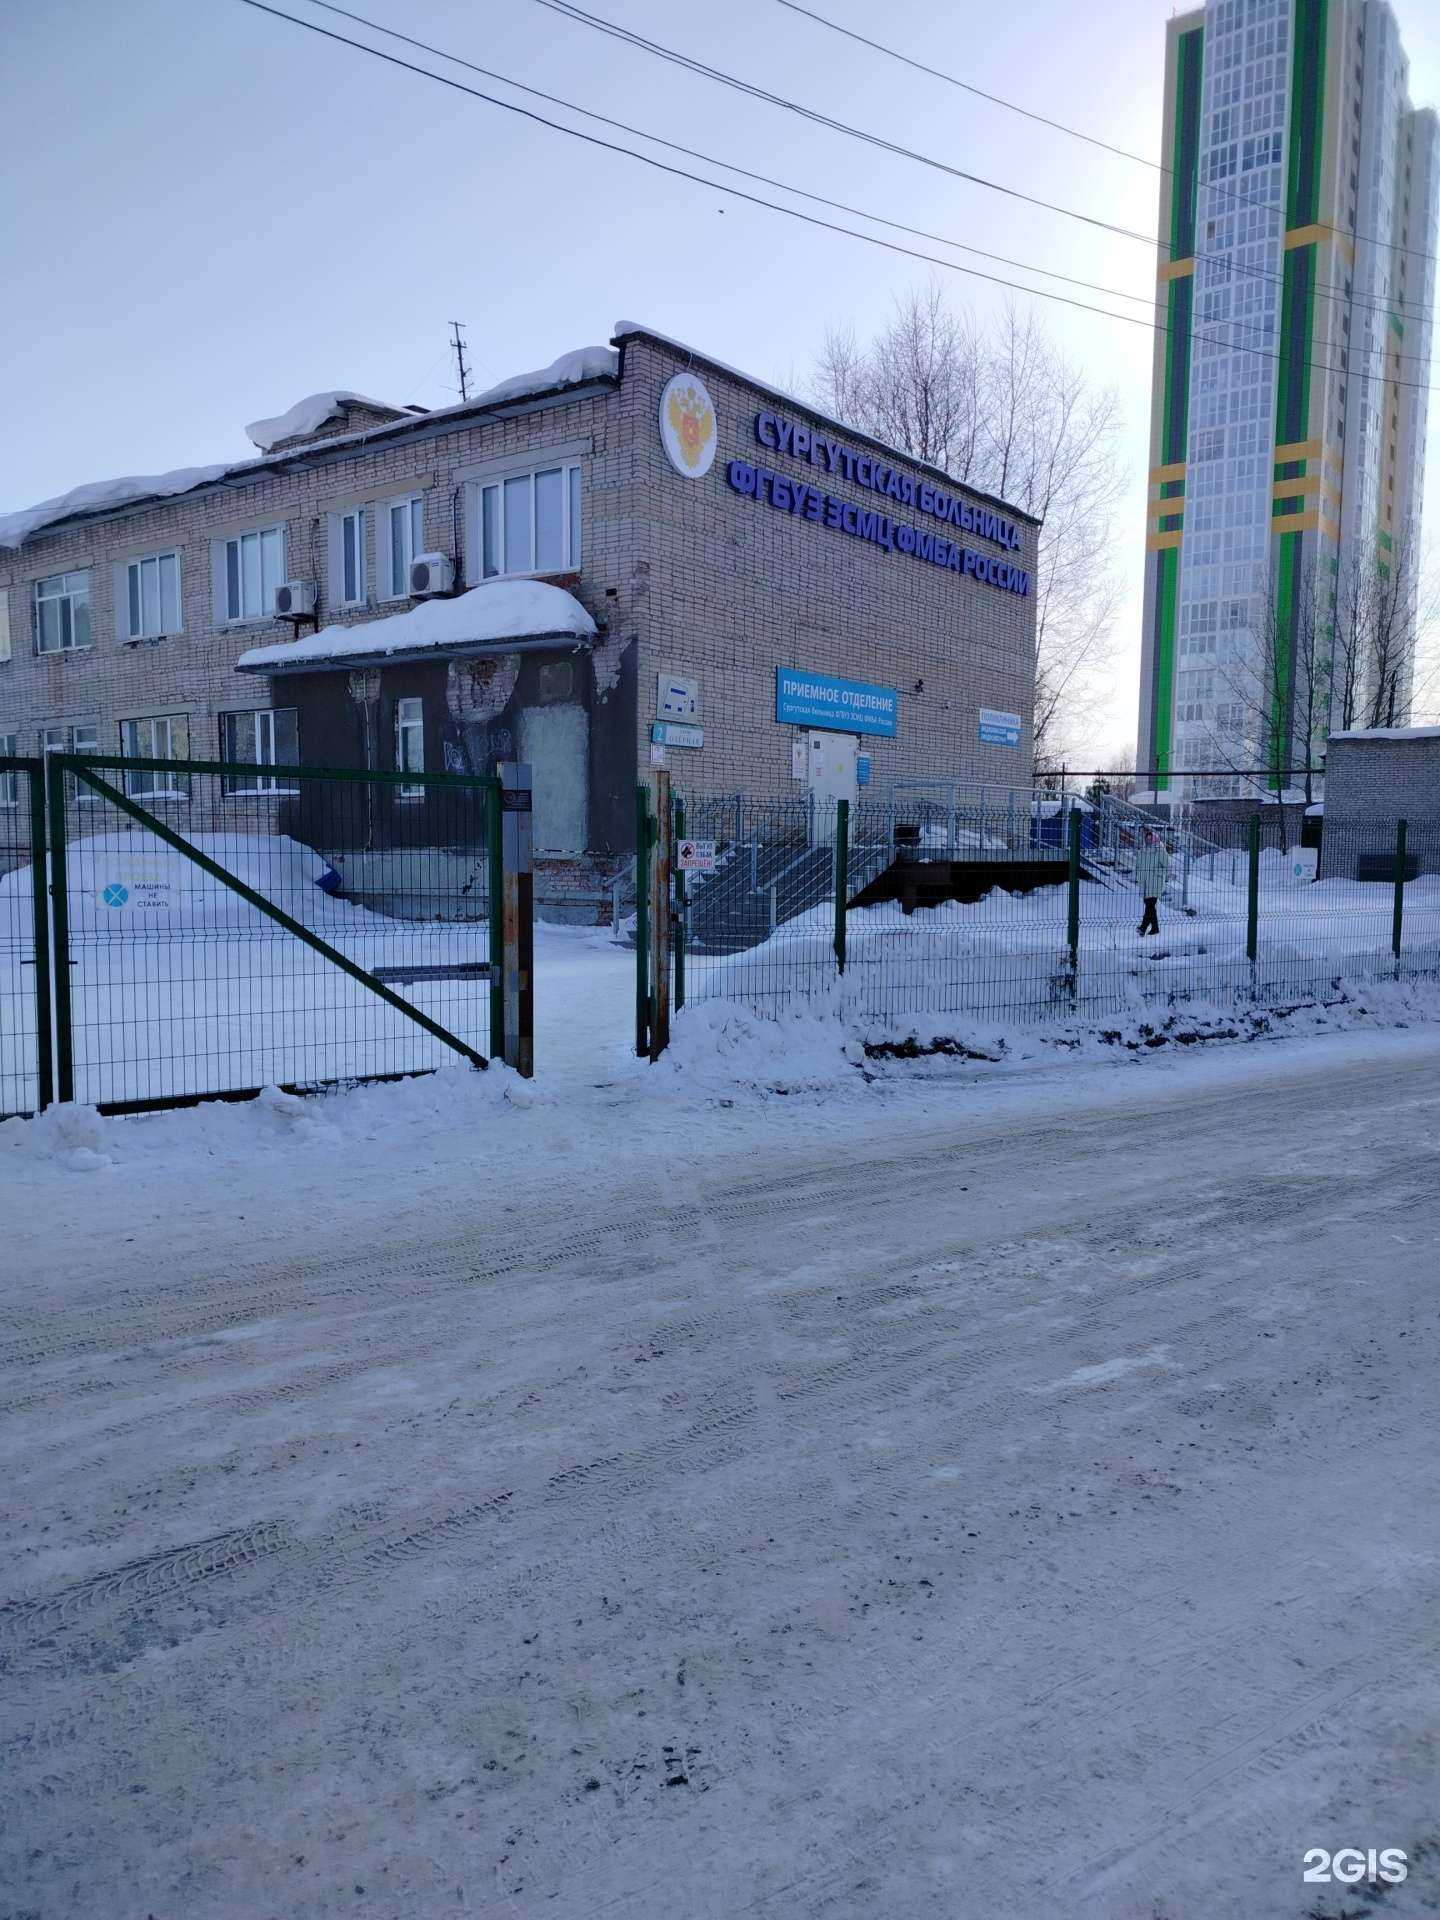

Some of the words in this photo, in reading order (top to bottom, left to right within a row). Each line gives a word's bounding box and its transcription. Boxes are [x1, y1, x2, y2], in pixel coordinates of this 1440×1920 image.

[756, 410, 916, 507] СУРГУТСКАЯ
[918, 483, 1022, 550] БОЛЬНИЦА
[729, 460, 824, 521] ФГБУЗ
[824, 495, 895, 552] ЗСМЦ
[897, 525, 960, 571] ФМБА
[962, 547, 1031, 597] РОССИИ
[783, 680, 839, 703] ПРИЕМНОЕ
[842, 691, 893, 712] ОТДЕЛЕНИЕ
[783, 702, 811, 714] Сургутская
